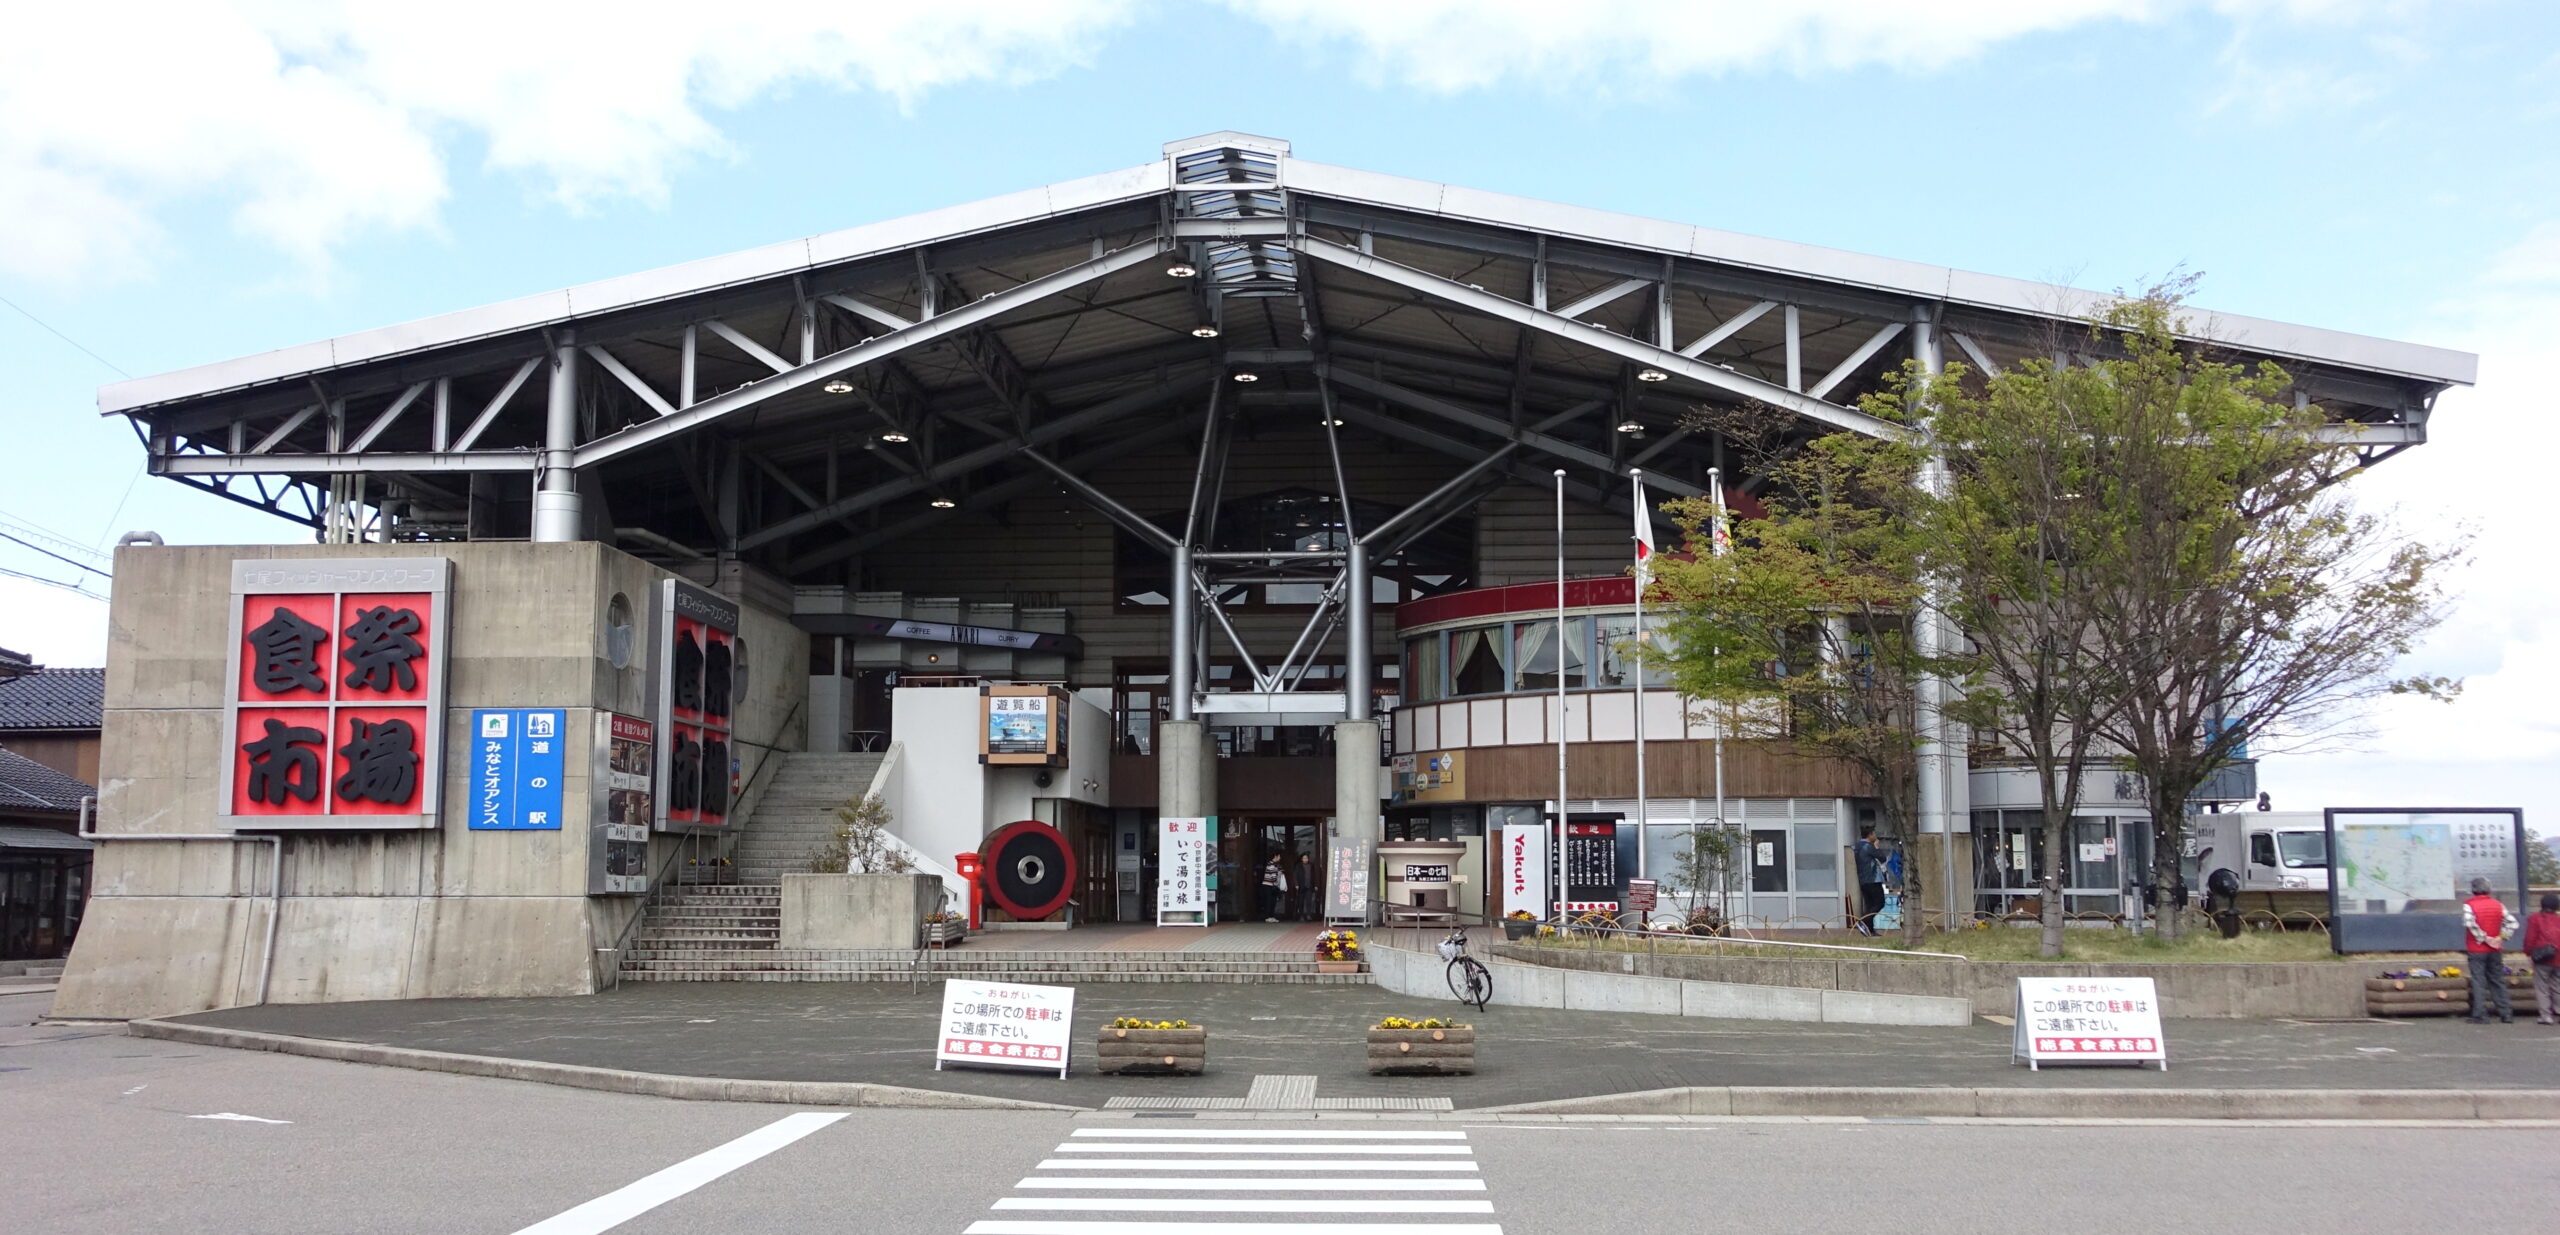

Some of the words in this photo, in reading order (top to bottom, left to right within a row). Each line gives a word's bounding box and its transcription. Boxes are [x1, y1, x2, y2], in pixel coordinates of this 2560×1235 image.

[996, 699, 1041, 711] 遊覧船
[483, 740, 502, 825] みなとオアシス
[528, 740, 550, 825] 道の駅
[1176, 840, 1189, 905] いで湯の旅
[1407, 866, 1447, 876] 日本一の七輪
[1513, 833, 1525, 896] Yakult
[987, 989, 1030, 999] おねがい
[2066, 984, 2111, 993] おねがい
[952, 1002, 1063, 1022] この場所での駐車は
[2033, 1000, 2149, 1014] この場所での駐車は
[950, 1021, 1029, 1040] ご遠慮下さい。
[2036, 1018, 2119, 1032] ご遠慮下さい。
